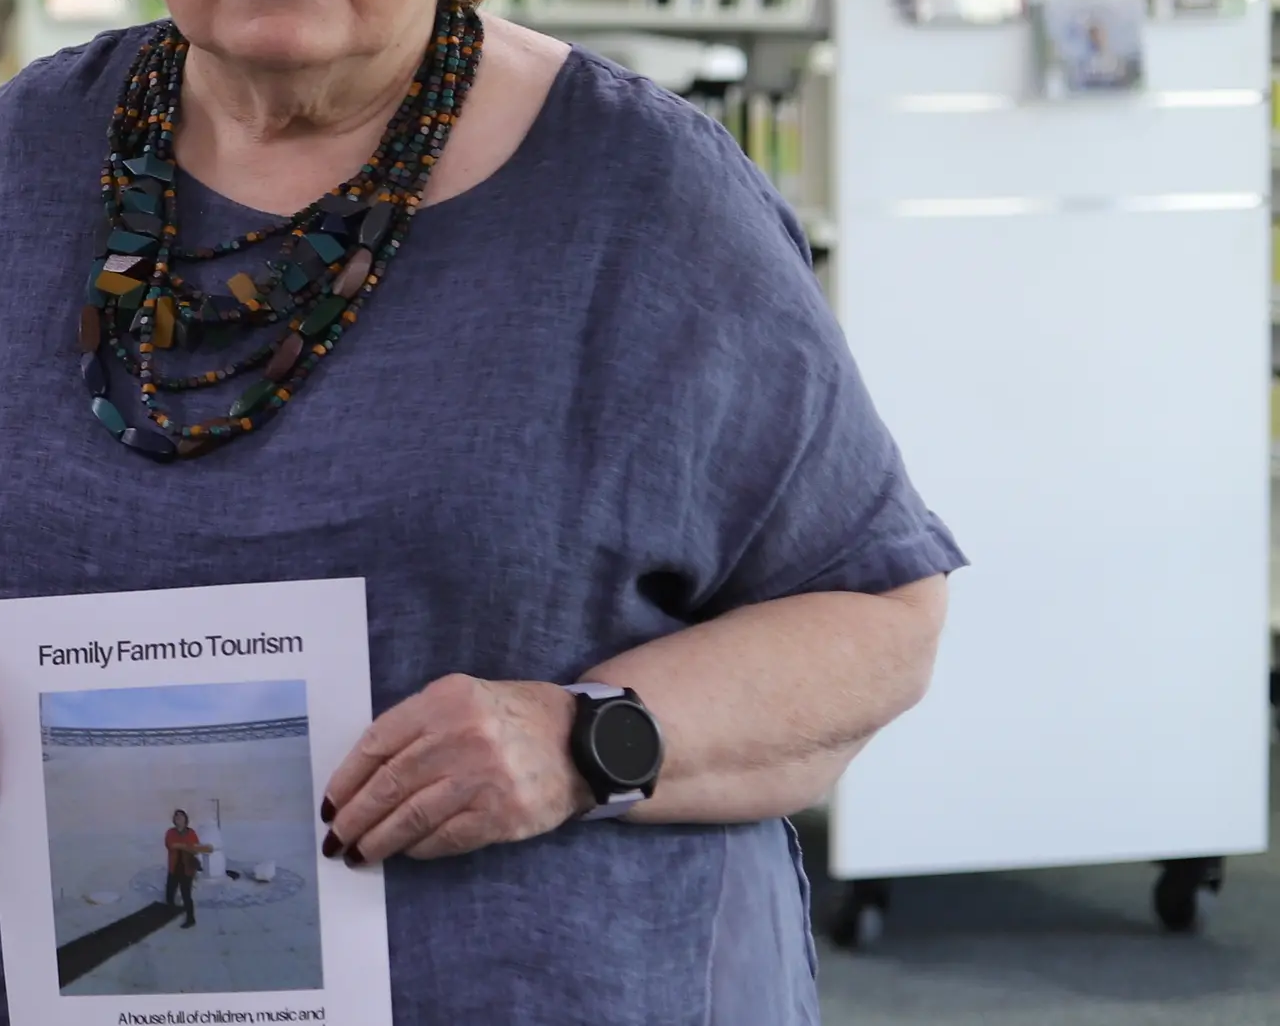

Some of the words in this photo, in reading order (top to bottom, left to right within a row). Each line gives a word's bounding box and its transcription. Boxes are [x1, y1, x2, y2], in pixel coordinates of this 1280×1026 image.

[38, 640, 114, 669] Family
[117, 640, 176, 662] Farm
[178, 637, 204, 659] to
[204, 632, 304, 658] Tourism
[118, 1012, 128, 1025] A
[128, 1011, 167, 1024] house
[167, 1010, 185, 1024] full
[186, 1010, 201, 1023] of
[199, 1009, 255, 1024] children,
[256, 1008, 297, 1023] music
[297, 1007, 325, 1021] and
